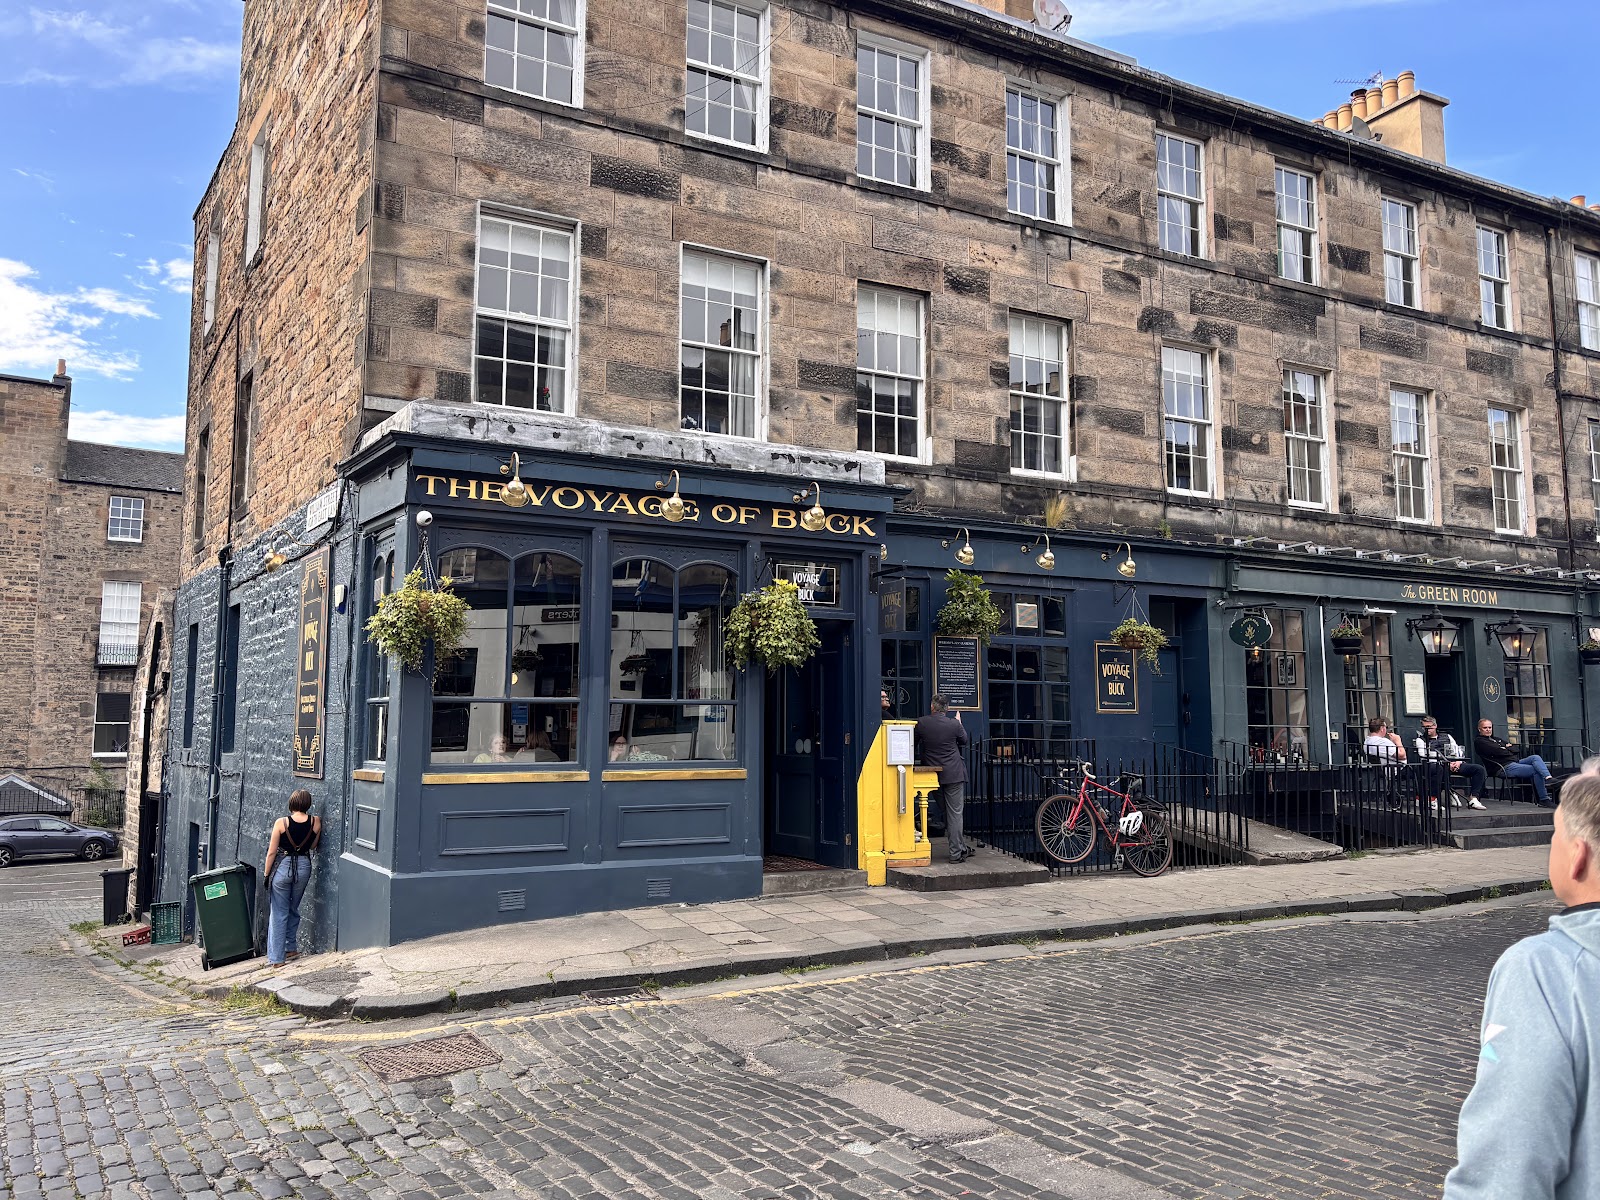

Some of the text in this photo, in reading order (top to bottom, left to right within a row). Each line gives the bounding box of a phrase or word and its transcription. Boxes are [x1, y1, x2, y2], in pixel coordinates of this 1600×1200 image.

[416, 474, 507, 502] THE
[523, 483, 700, 522] VOYAGE
[711, 504, 761, 525] OF
[792, 572, 820, 587] VOYAGE
[797, 588, 815, 601] BUCK
[881, 591, 902, 610] VOYAGE
[1401, 584, 1498, 605] The GREEN ROOM
[884, 613, 897, 629] BUCK
[1101, 663, 1131, 680] VOYAGE
[1108, 682, 1126, 696] BUCK
